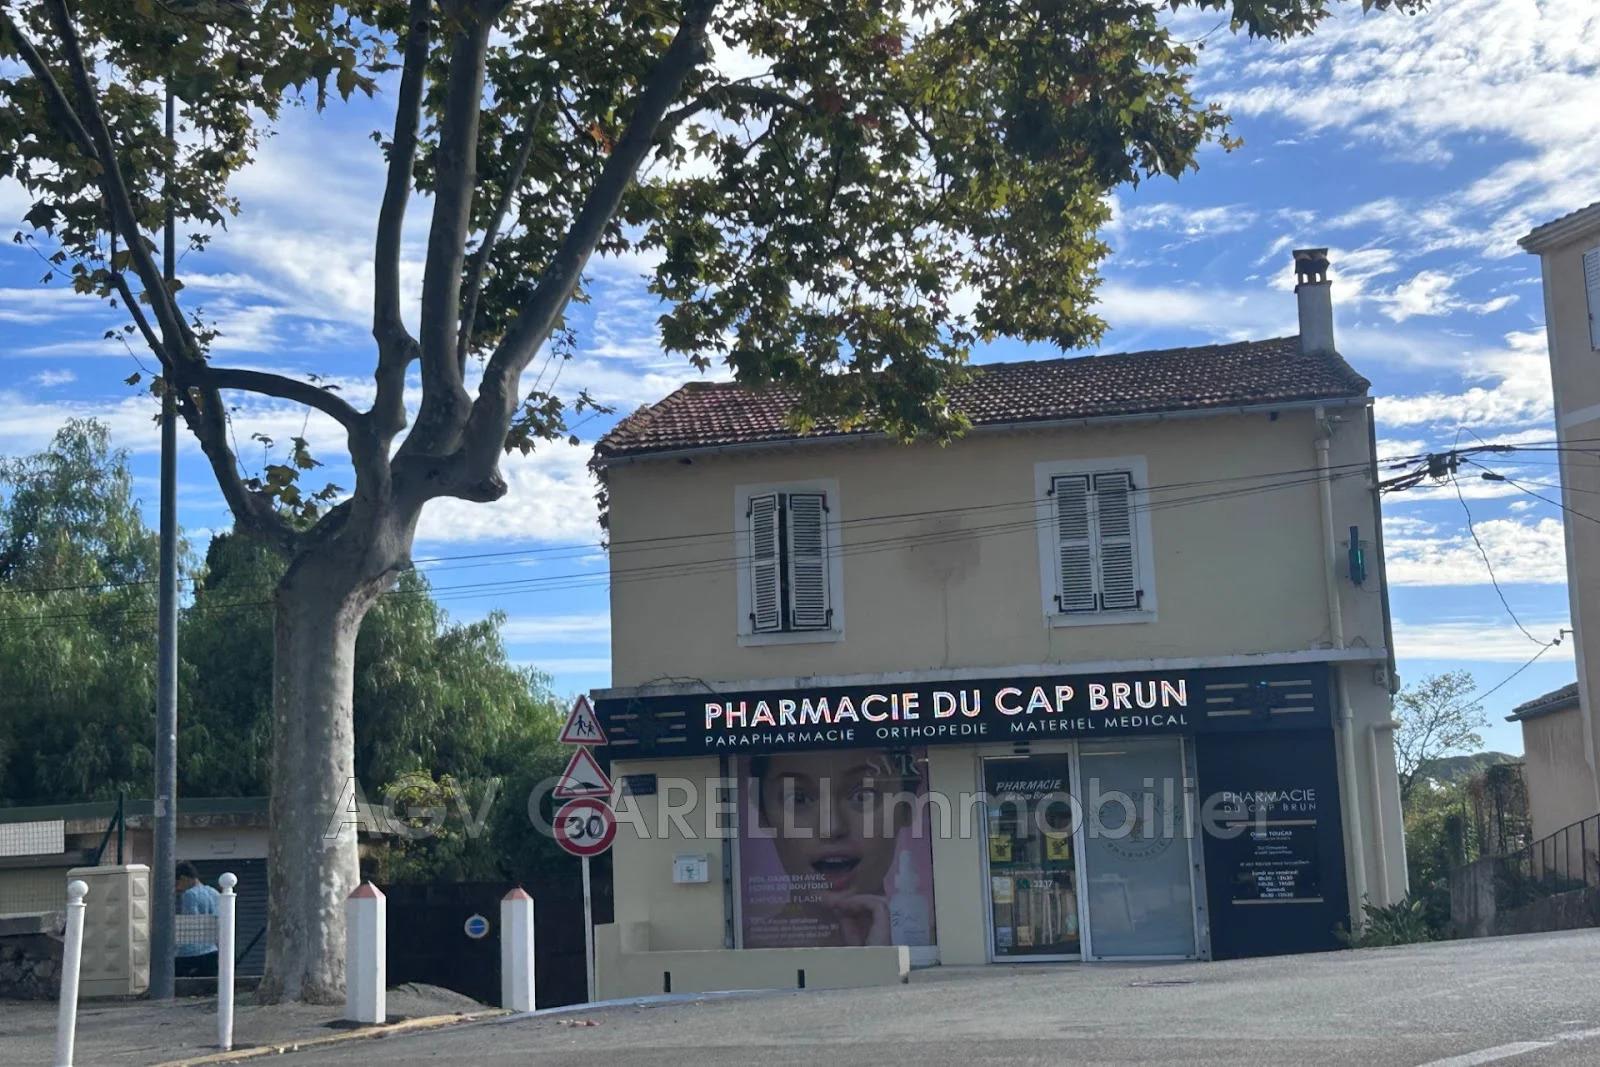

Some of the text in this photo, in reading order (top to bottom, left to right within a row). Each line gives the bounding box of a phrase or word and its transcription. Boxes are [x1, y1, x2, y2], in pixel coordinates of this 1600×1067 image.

[705, 679, 1188, 730] PHARMACIE DU CAP BRUN
[705, 712, 1188, 747] PARAPHARMACIE ORTHOPEDIE MATERIEL MEDICAL
[995, 779, 1062, 792] PHARMACIE
[1222, 788, 1317, 803] PHARMACIE
[1282, 802, 1317, 812] BRUN
[568, 815, 604, 840] 30
